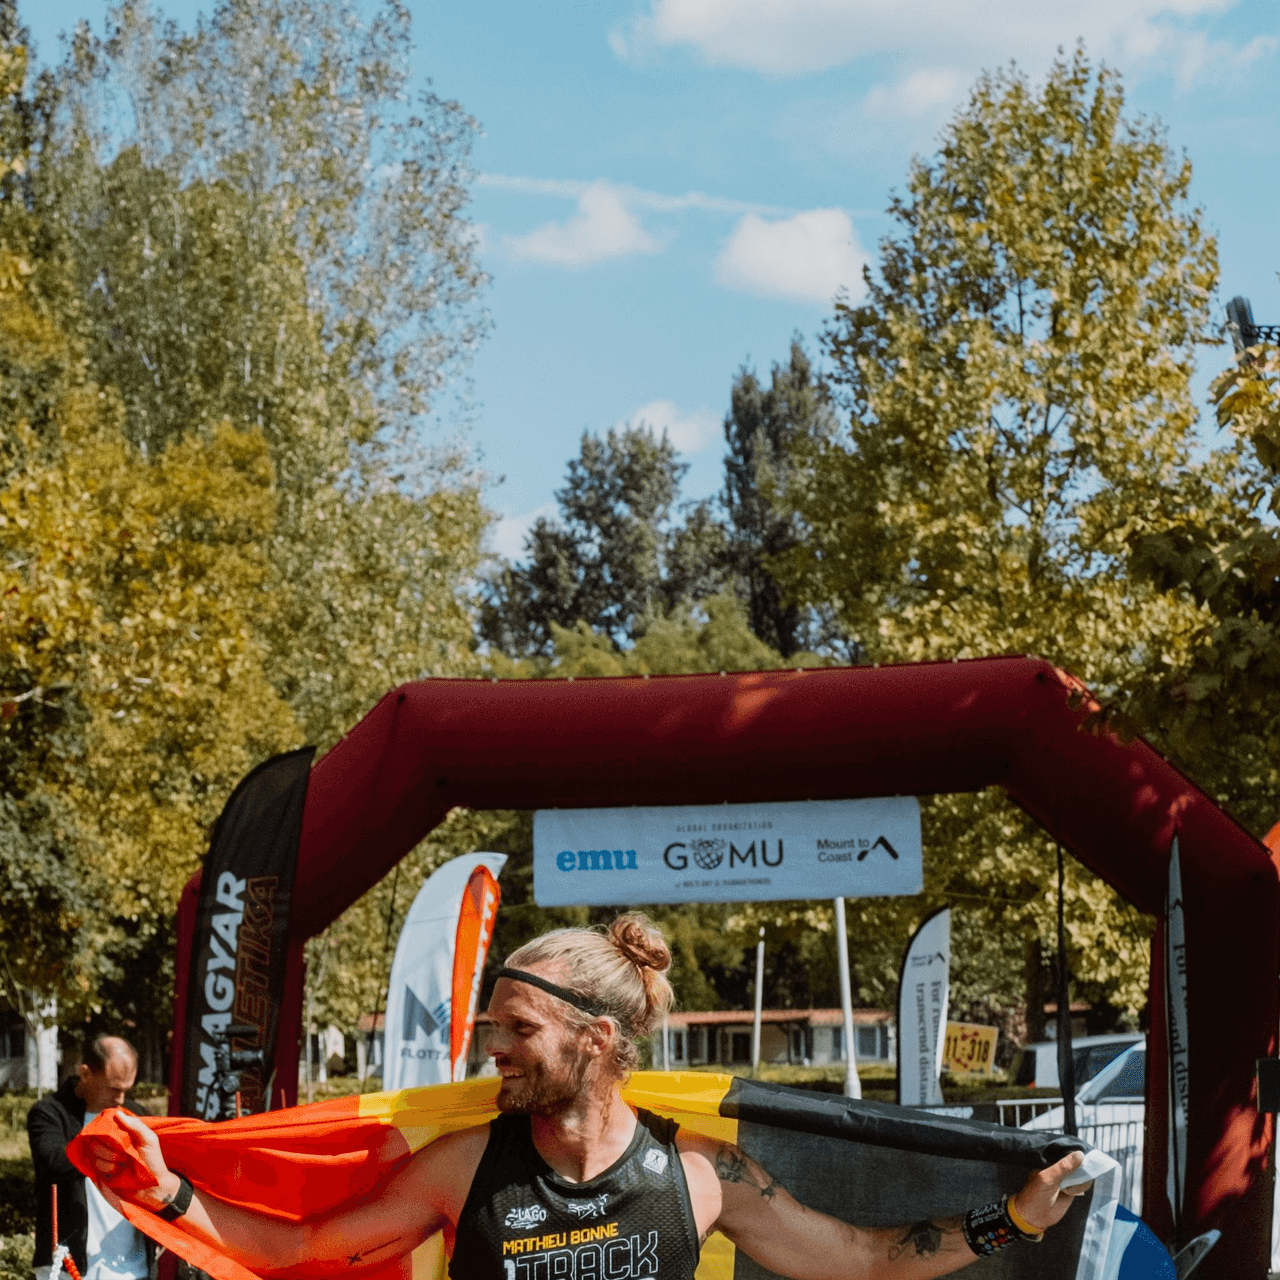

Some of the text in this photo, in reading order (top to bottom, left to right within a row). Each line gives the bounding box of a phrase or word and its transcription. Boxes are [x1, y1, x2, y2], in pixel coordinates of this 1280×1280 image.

[556, 849, 638, 872] emu
[663, 839, 784, 871] GOMU
[503, 1223, 618, 1255] MATTHIEU BONNE
